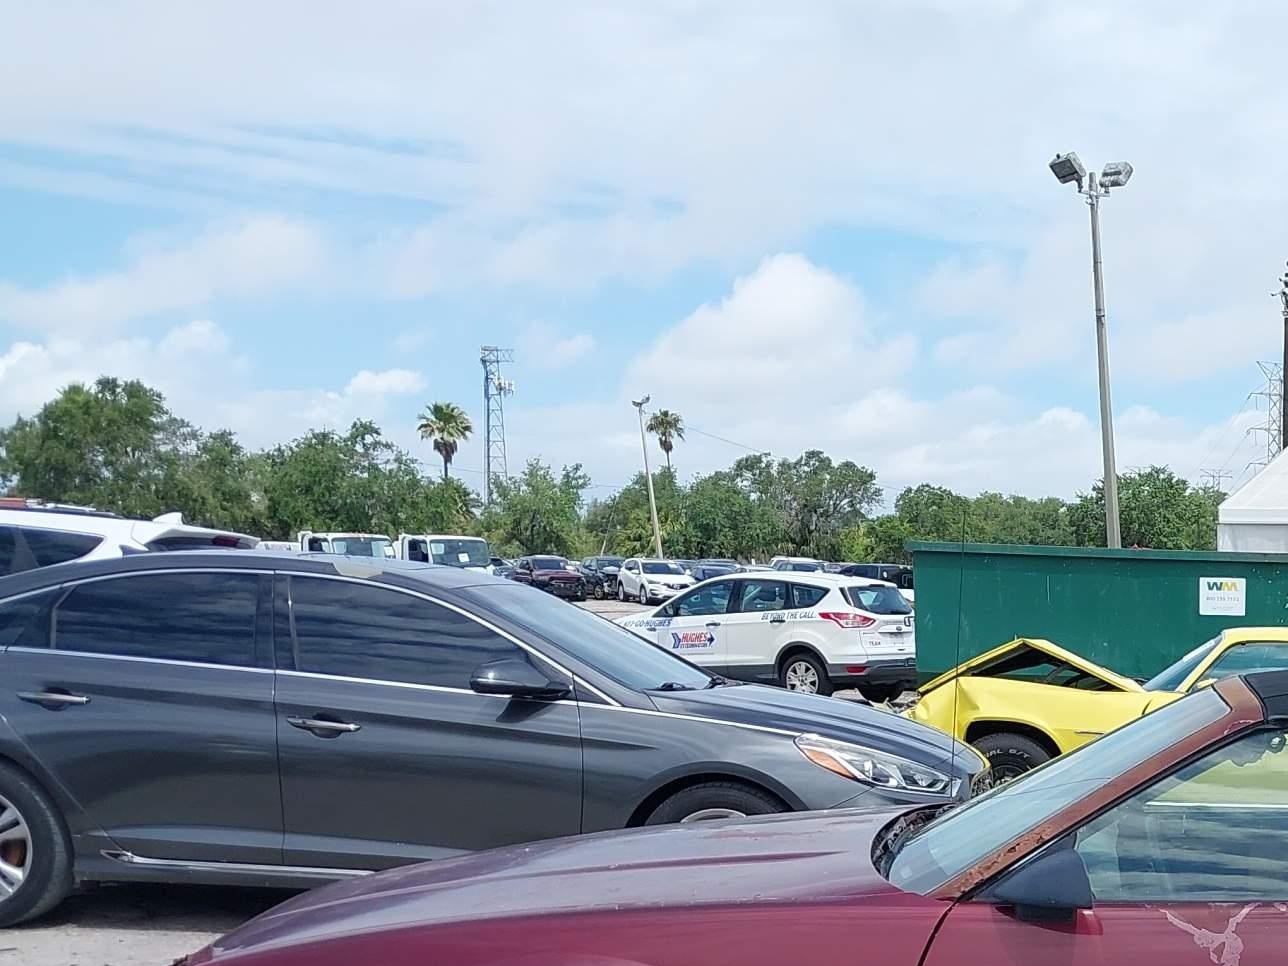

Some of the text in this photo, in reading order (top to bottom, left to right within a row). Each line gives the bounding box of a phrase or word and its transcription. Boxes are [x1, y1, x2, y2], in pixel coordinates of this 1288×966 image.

[1207, 581, 1237, 591] WM
[787, 611, 800, 619] THE
[681, 632, 708, 643] HUGHES
